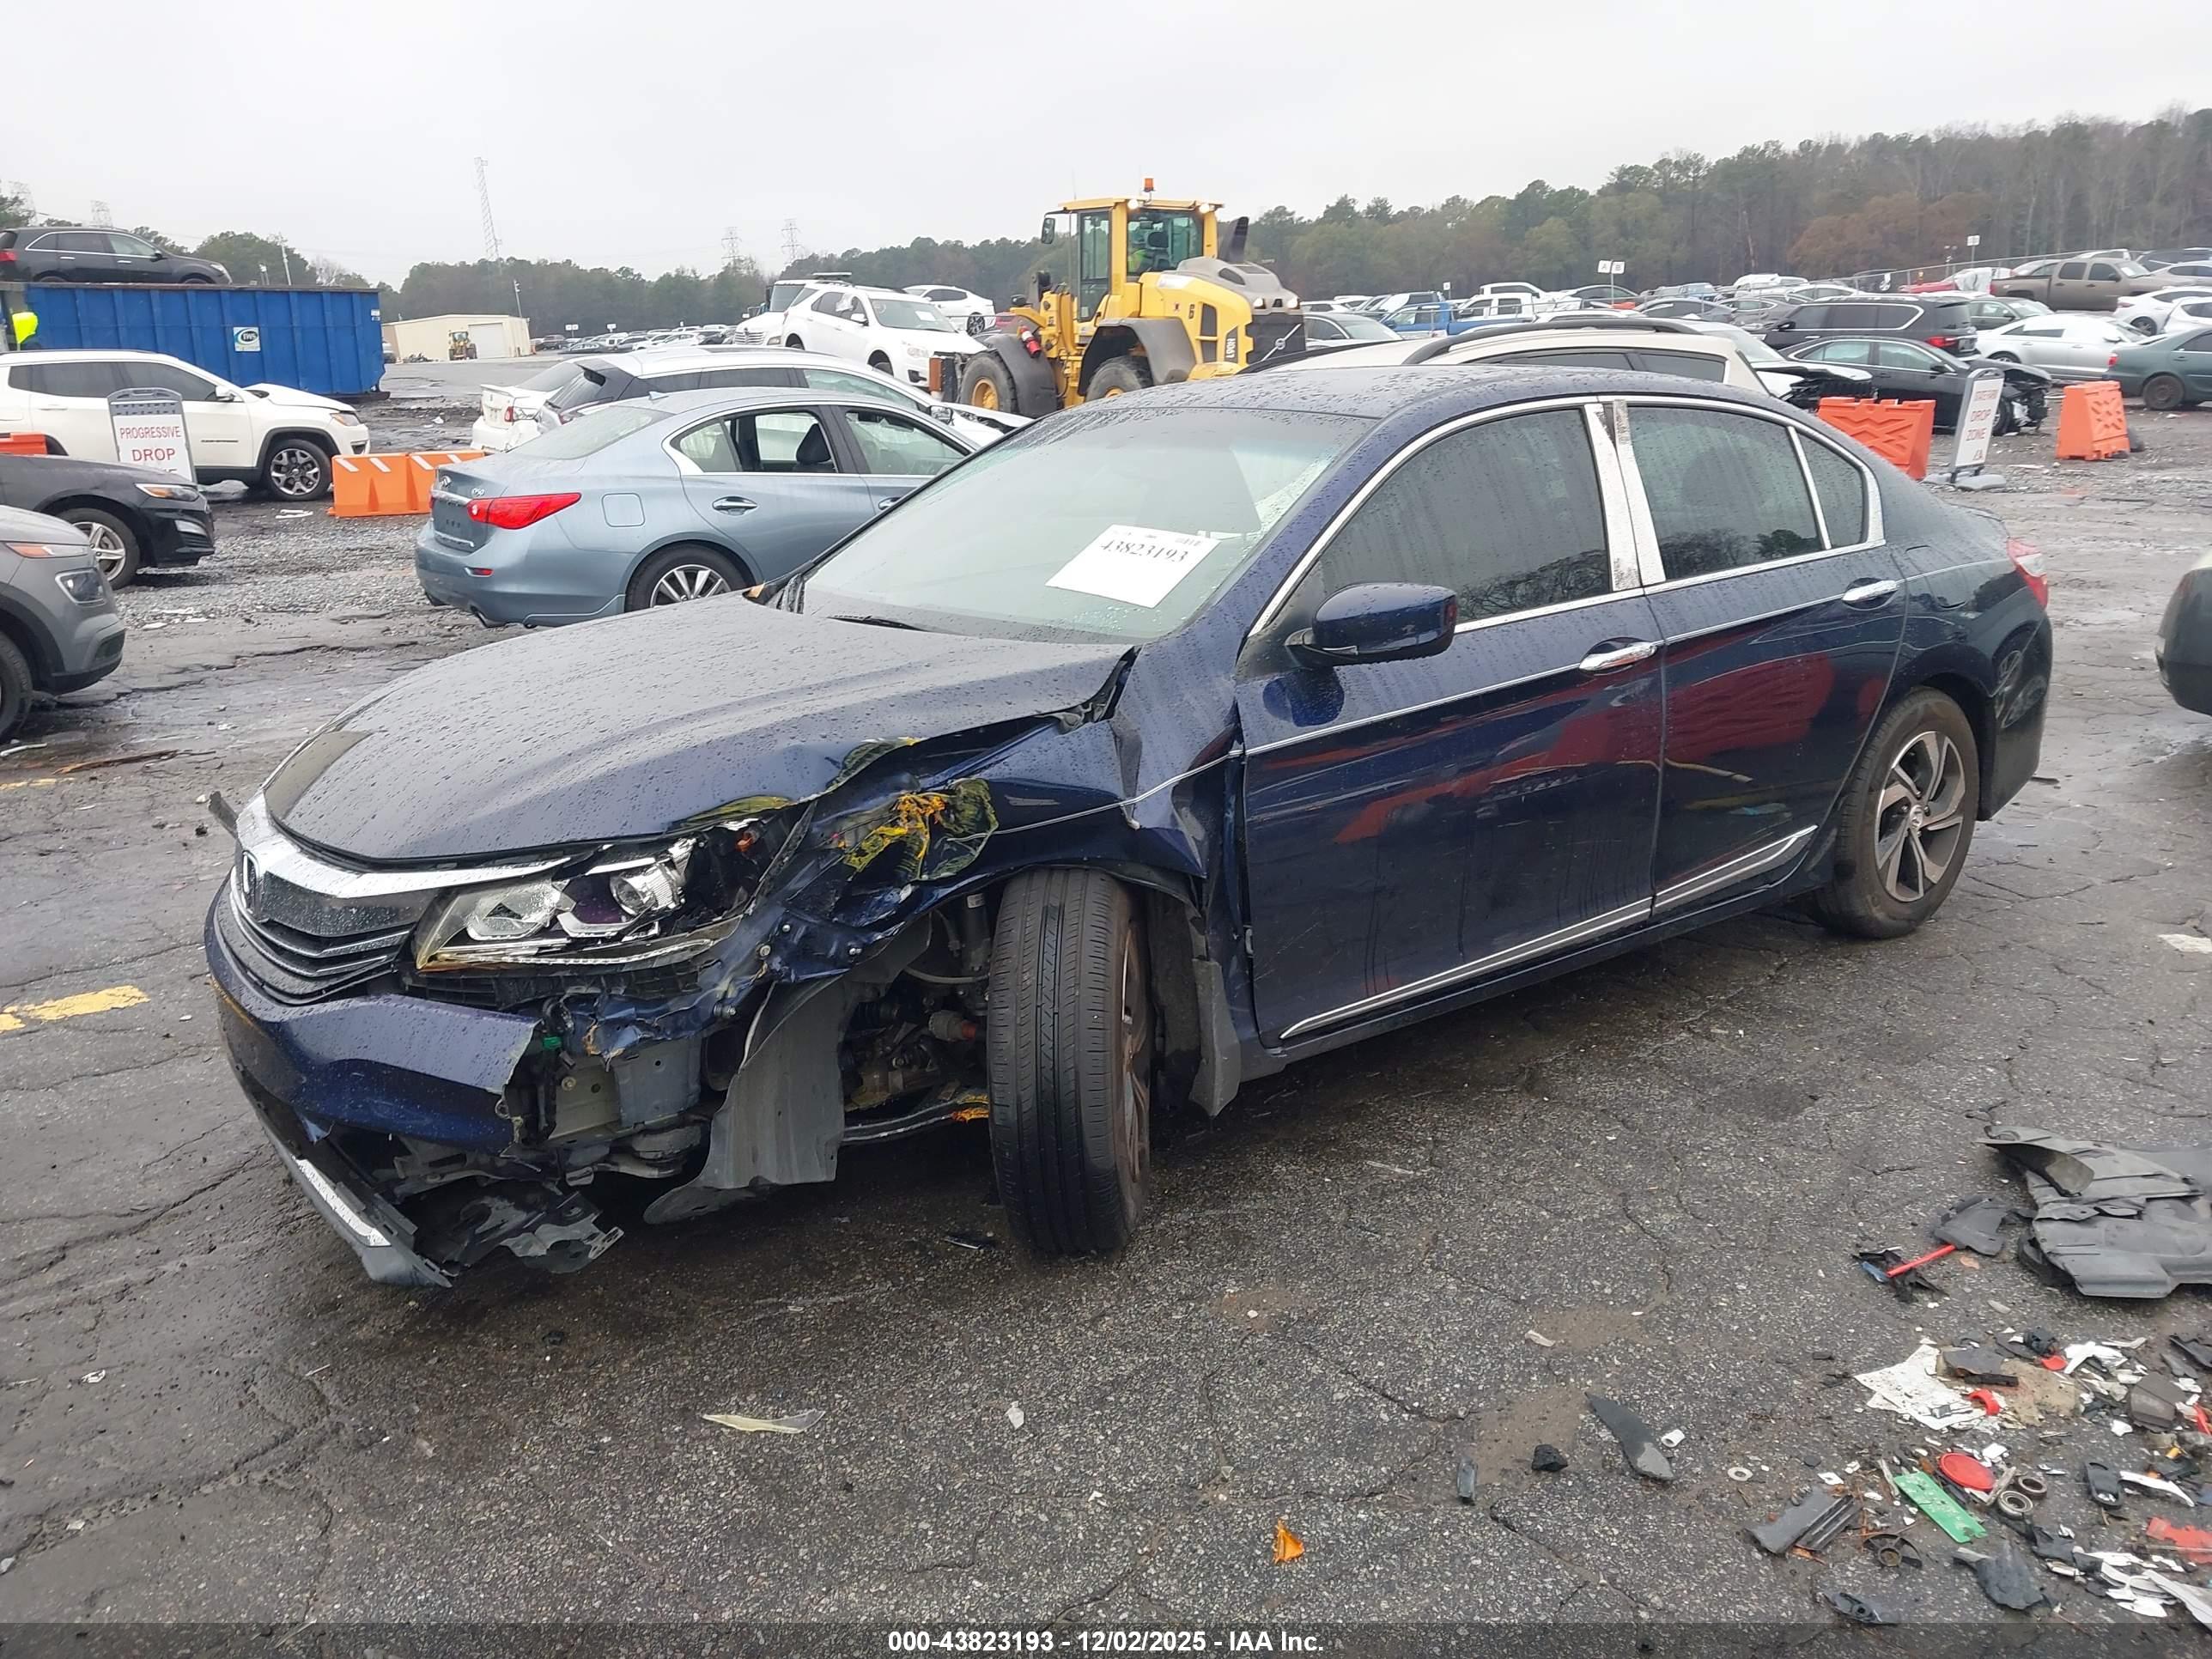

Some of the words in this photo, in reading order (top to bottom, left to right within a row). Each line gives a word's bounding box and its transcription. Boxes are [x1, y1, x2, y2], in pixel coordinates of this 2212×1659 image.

[119, 426, 182, 439] PROGRESSIVE
[131, 448, 176, 462] DROP
[1101, 539, 1188, 562] 43823193
